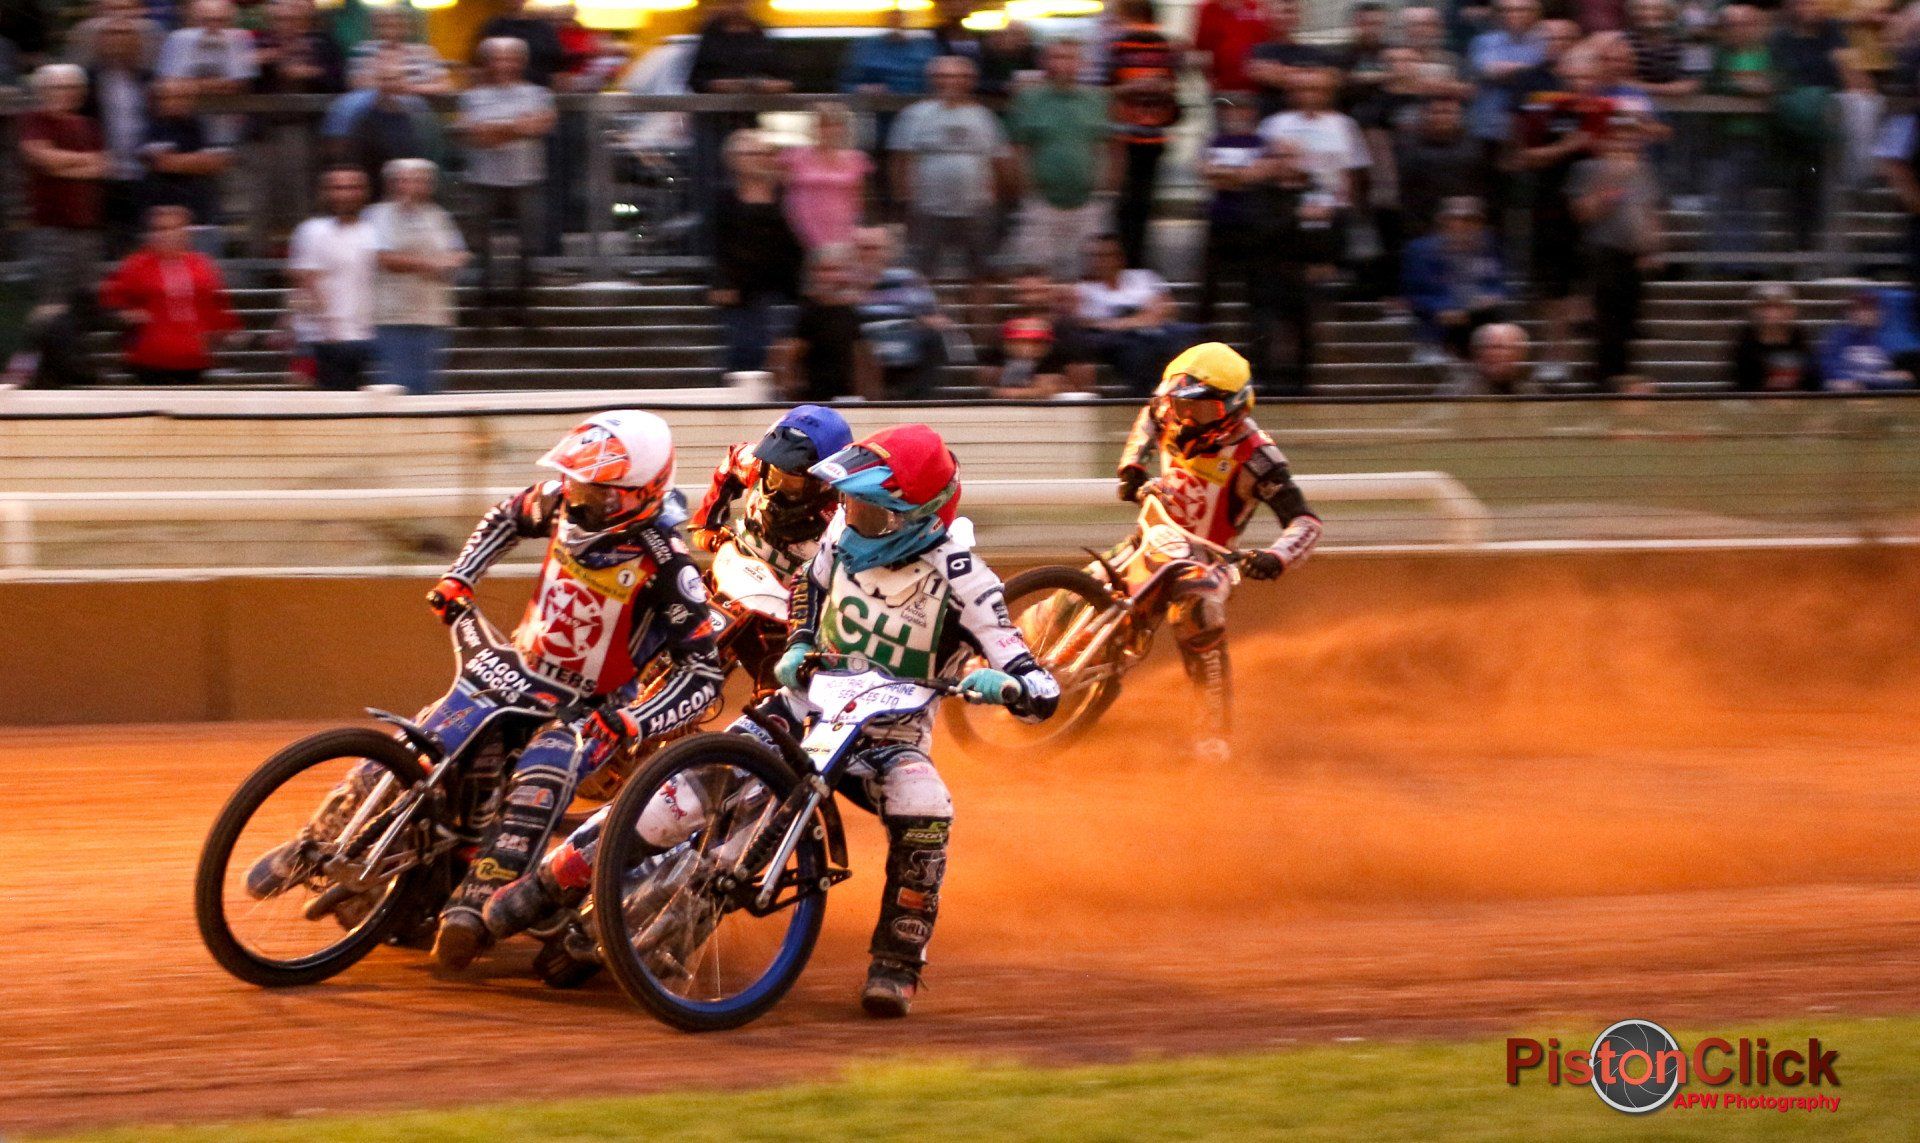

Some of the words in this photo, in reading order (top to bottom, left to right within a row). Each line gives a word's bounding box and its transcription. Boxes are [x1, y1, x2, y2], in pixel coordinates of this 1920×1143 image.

[930, 578, 943, 595] 1
[465, 658, 520, 704] SHOCKS
[475, 648, 532, 692] HAGON
[650, 681, 716, 731] HAGON
[838, 688, 877, 702] SERCES
